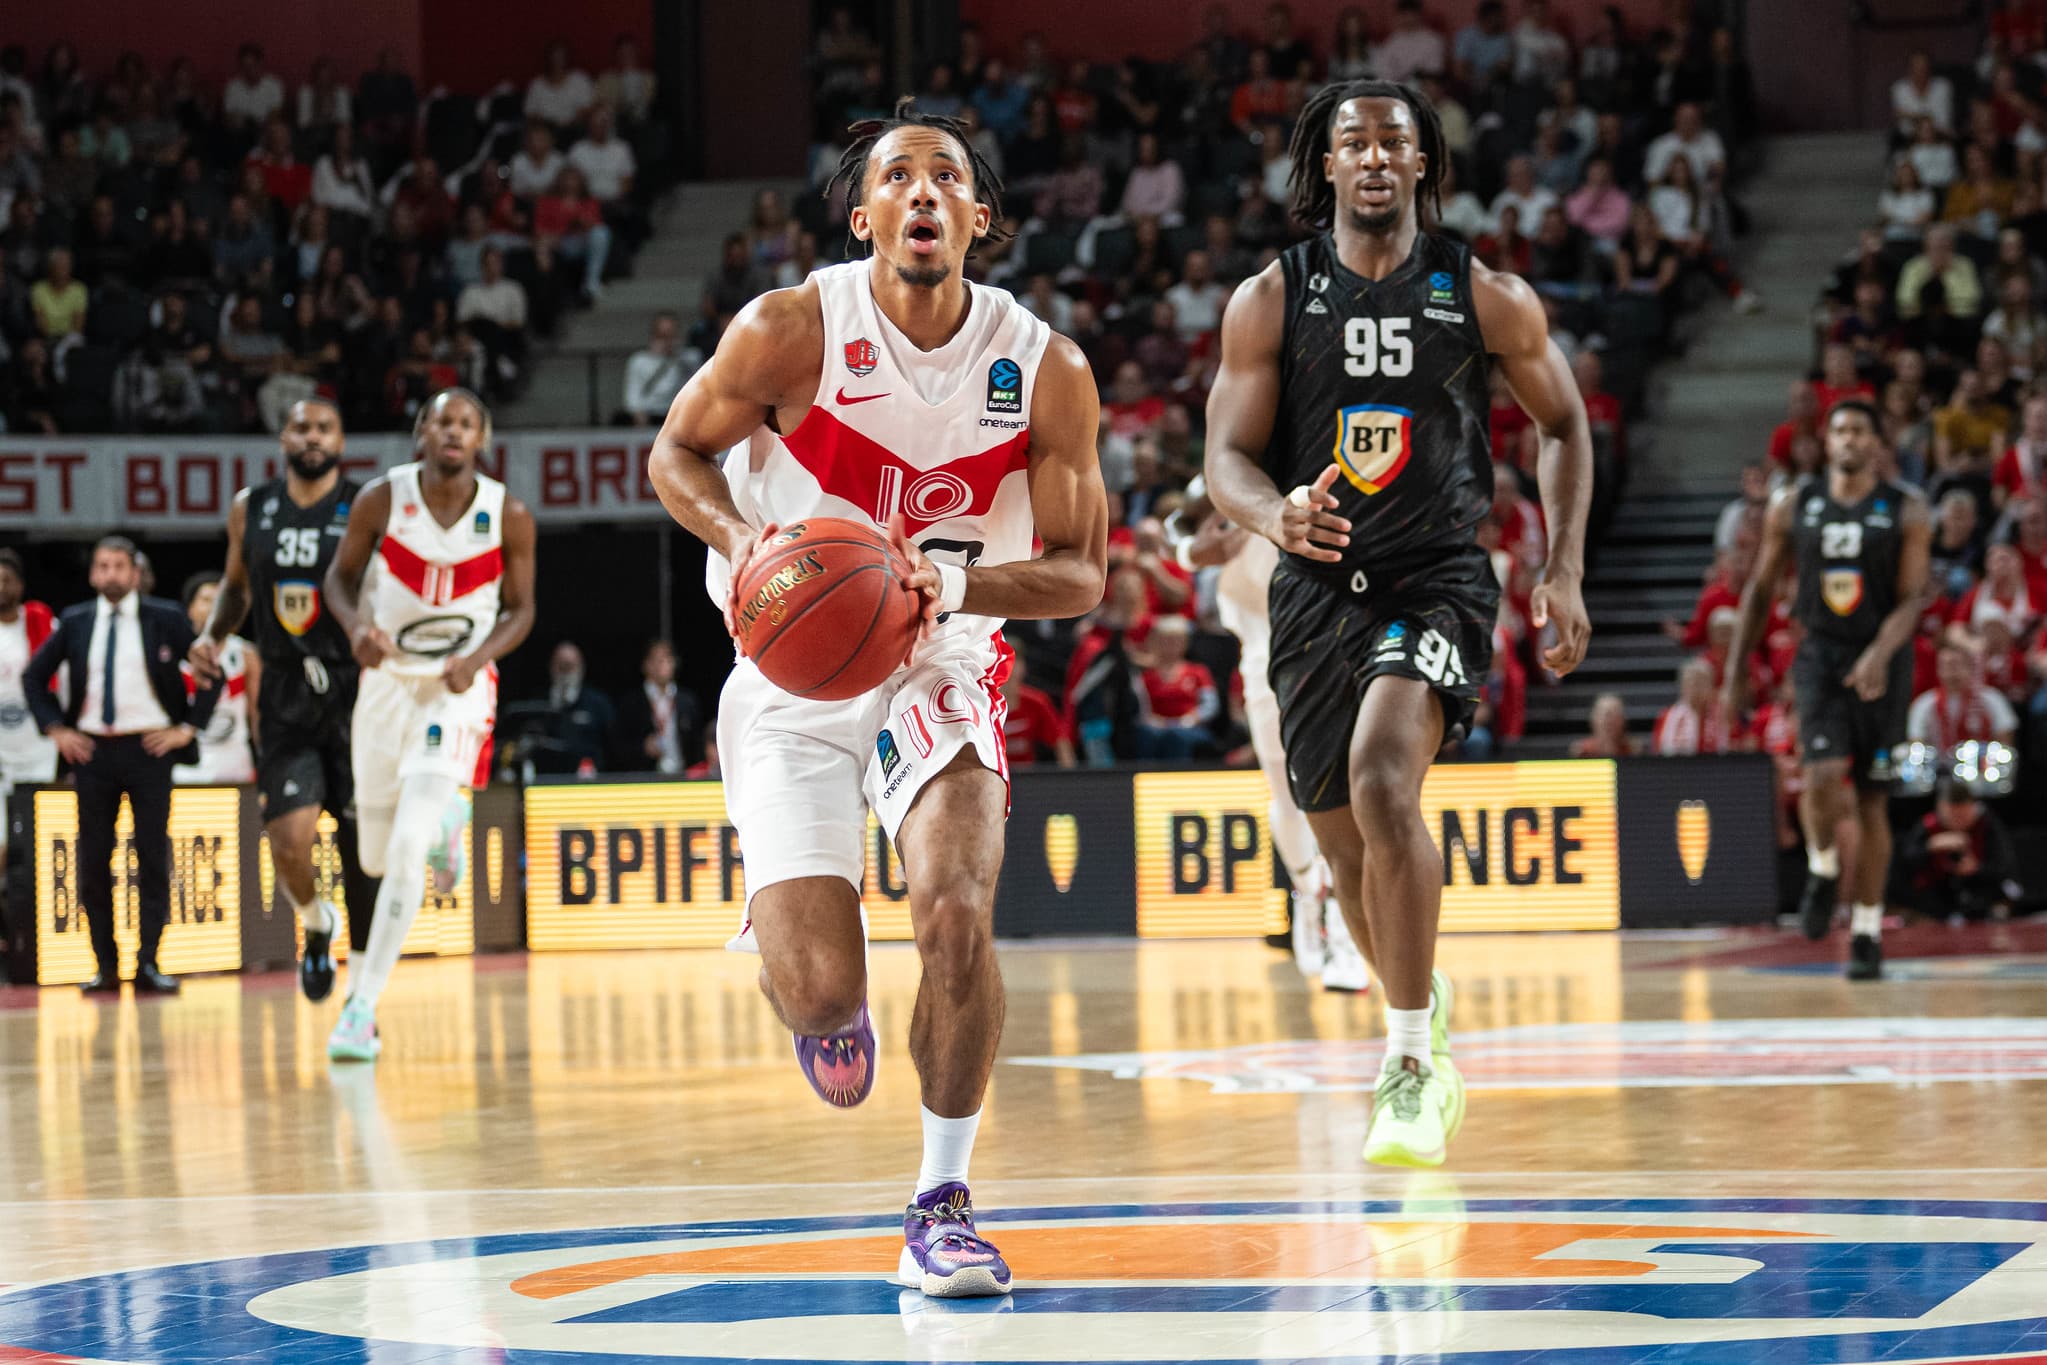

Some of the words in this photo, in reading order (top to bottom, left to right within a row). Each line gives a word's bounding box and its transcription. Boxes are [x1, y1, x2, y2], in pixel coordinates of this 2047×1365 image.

[1344, 316, 1414, 378] 95
[988, 400, 1020, 411] EuroCup
[992, 390, 1017, 400] BKT
[979, 418, 1028, 430] oneteam
[1351, 426, 1397, 453] BT
[876, 464, 974, 529] 10
[275, 527, 320, 568] 35
[883, 762, 913, 800] oneteam
